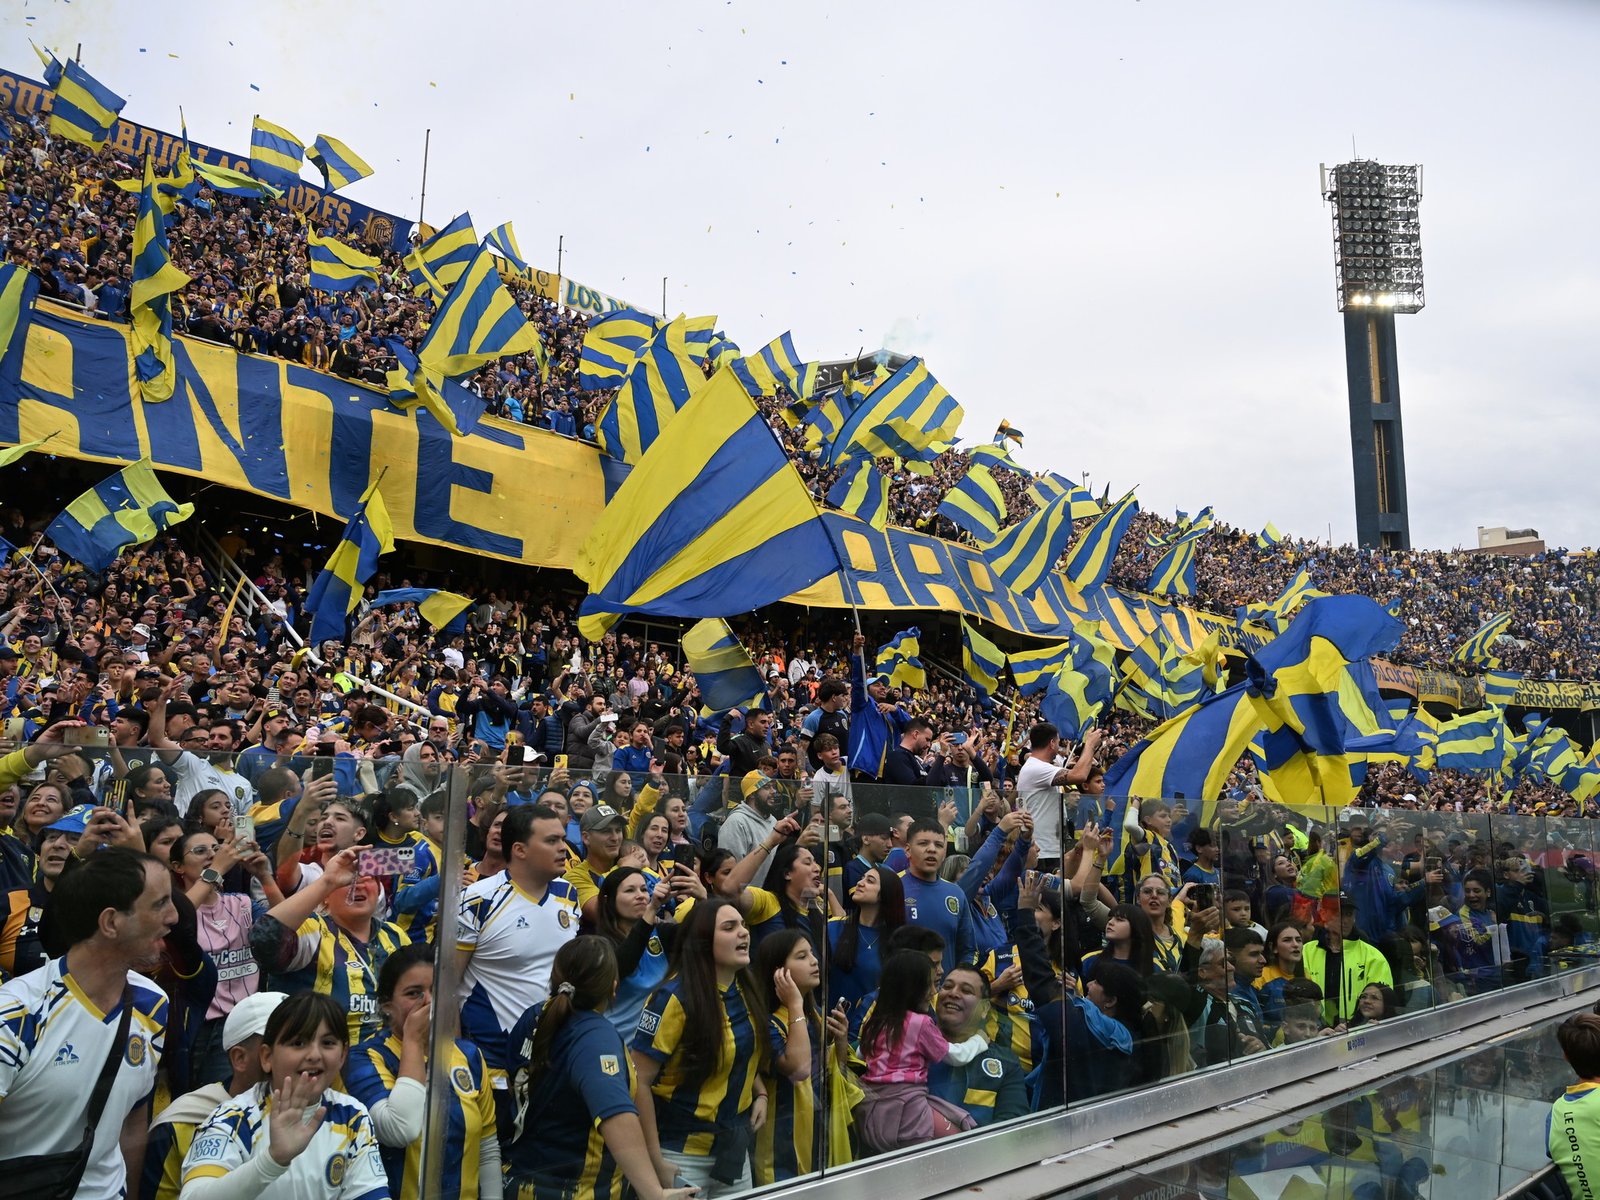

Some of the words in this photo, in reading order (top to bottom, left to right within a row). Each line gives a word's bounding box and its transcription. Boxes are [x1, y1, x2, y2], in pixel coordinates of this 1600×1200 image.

[567, 278, 604, 314] LOS
[1517, 680, 1550, 694] OCOS
[1514, 691, 1580, 708] BORRACHOS
[911, 907, 918, 919] 3
[1563, 1111, 1574, 1124] LE
[1572, 1154, 1597, 1200] SPORTI
